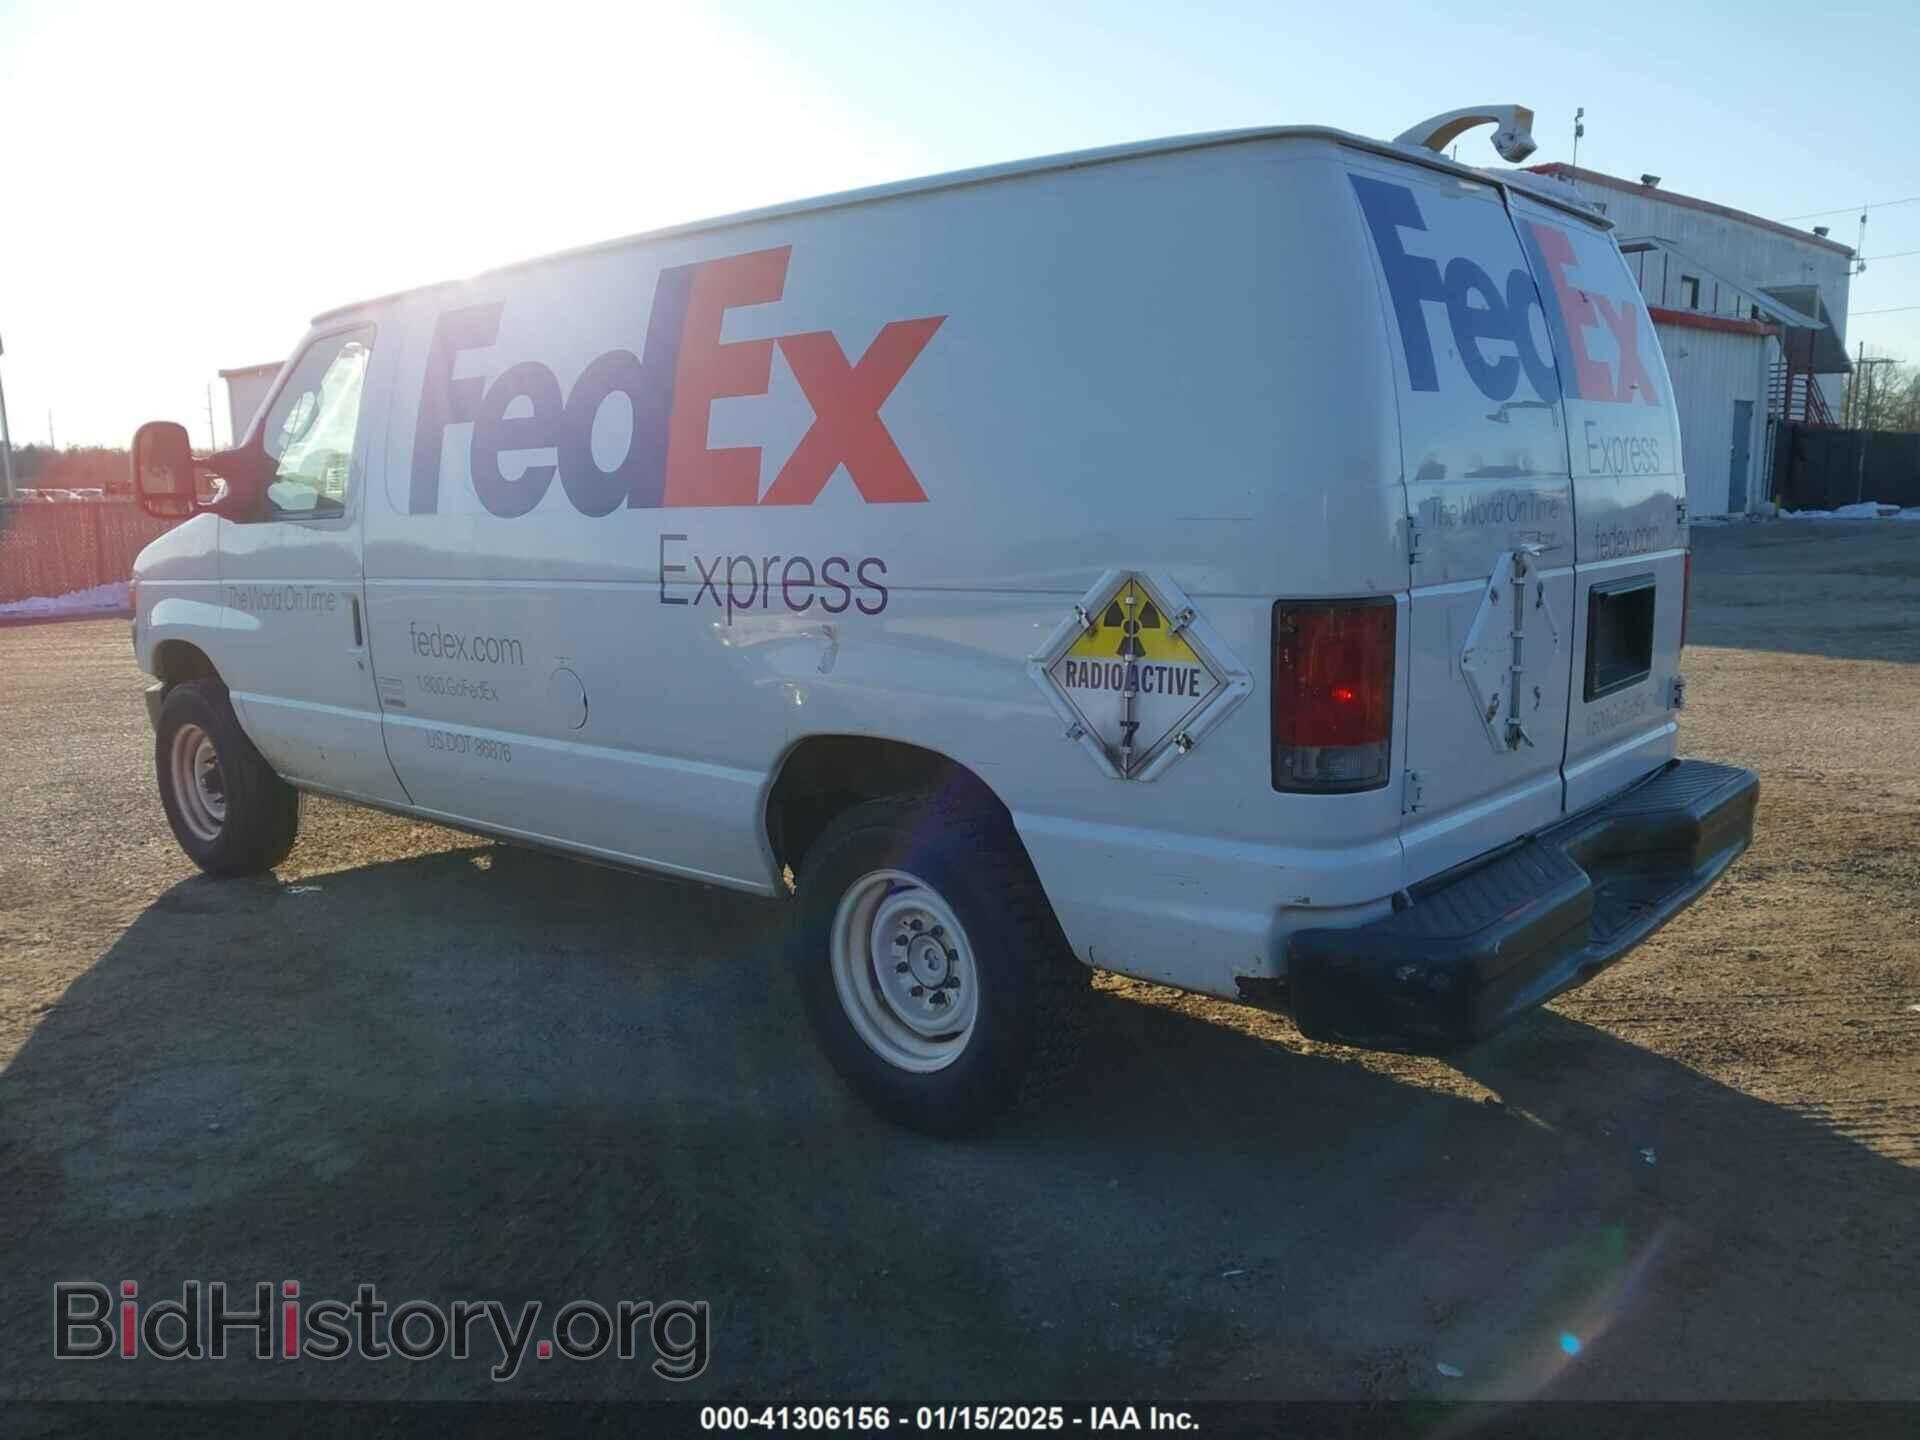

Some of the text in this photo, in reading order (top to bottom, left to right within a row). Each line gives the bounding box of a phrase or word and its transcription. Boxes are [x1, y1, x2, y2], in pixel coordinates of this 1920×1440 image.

[1347, 172, 1661, 407] FedEx
[409, 244, 948, 519] FedEx
[1584, 420, 1660, 488] Express
[1430, 492, 1559, 527] The World On Time
[227, 584, 336, 612] The World On Time
[659, 534, 888, 626] Express
[408, 620, 524, 665] fedex.com
[1065, 660, 1201, 697] RADIOACTIVE
